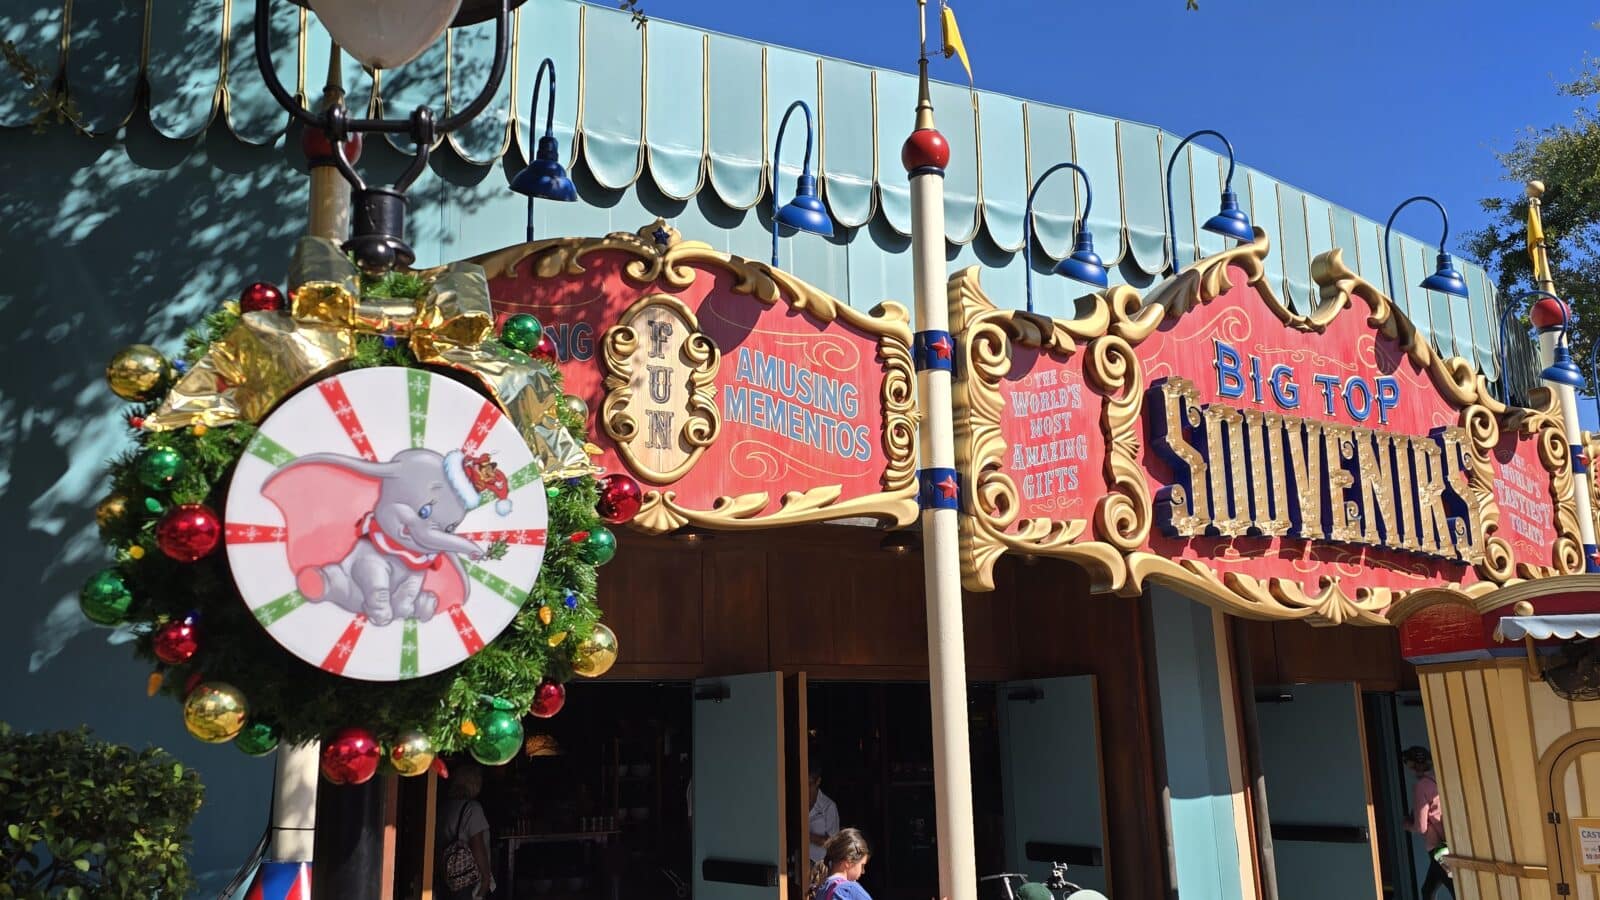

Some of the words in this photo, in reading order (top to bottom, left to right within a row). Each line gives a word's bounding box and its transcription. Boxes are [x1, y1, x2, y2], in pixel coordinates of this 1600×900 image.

[645, 320, 673, 450] FUN
[735, 346, 860, 418] AMUSING
[1010, 383, 1082, 417] WORLD'S
[1033, 369, 1057, 387] THE
[1213, 338, 1299, 409] BIG
[1313, 373, 1399, 424] TOP
[724, 385, 872, 461] MEMENTOS
[1030, 411, 1072, 439] MOST
[1011, 434, 1088, 470] AMAZING
[1157, 375, 1484, 565] SOUVENIRS
[1022, 465, 1079, 500] GIFTS
